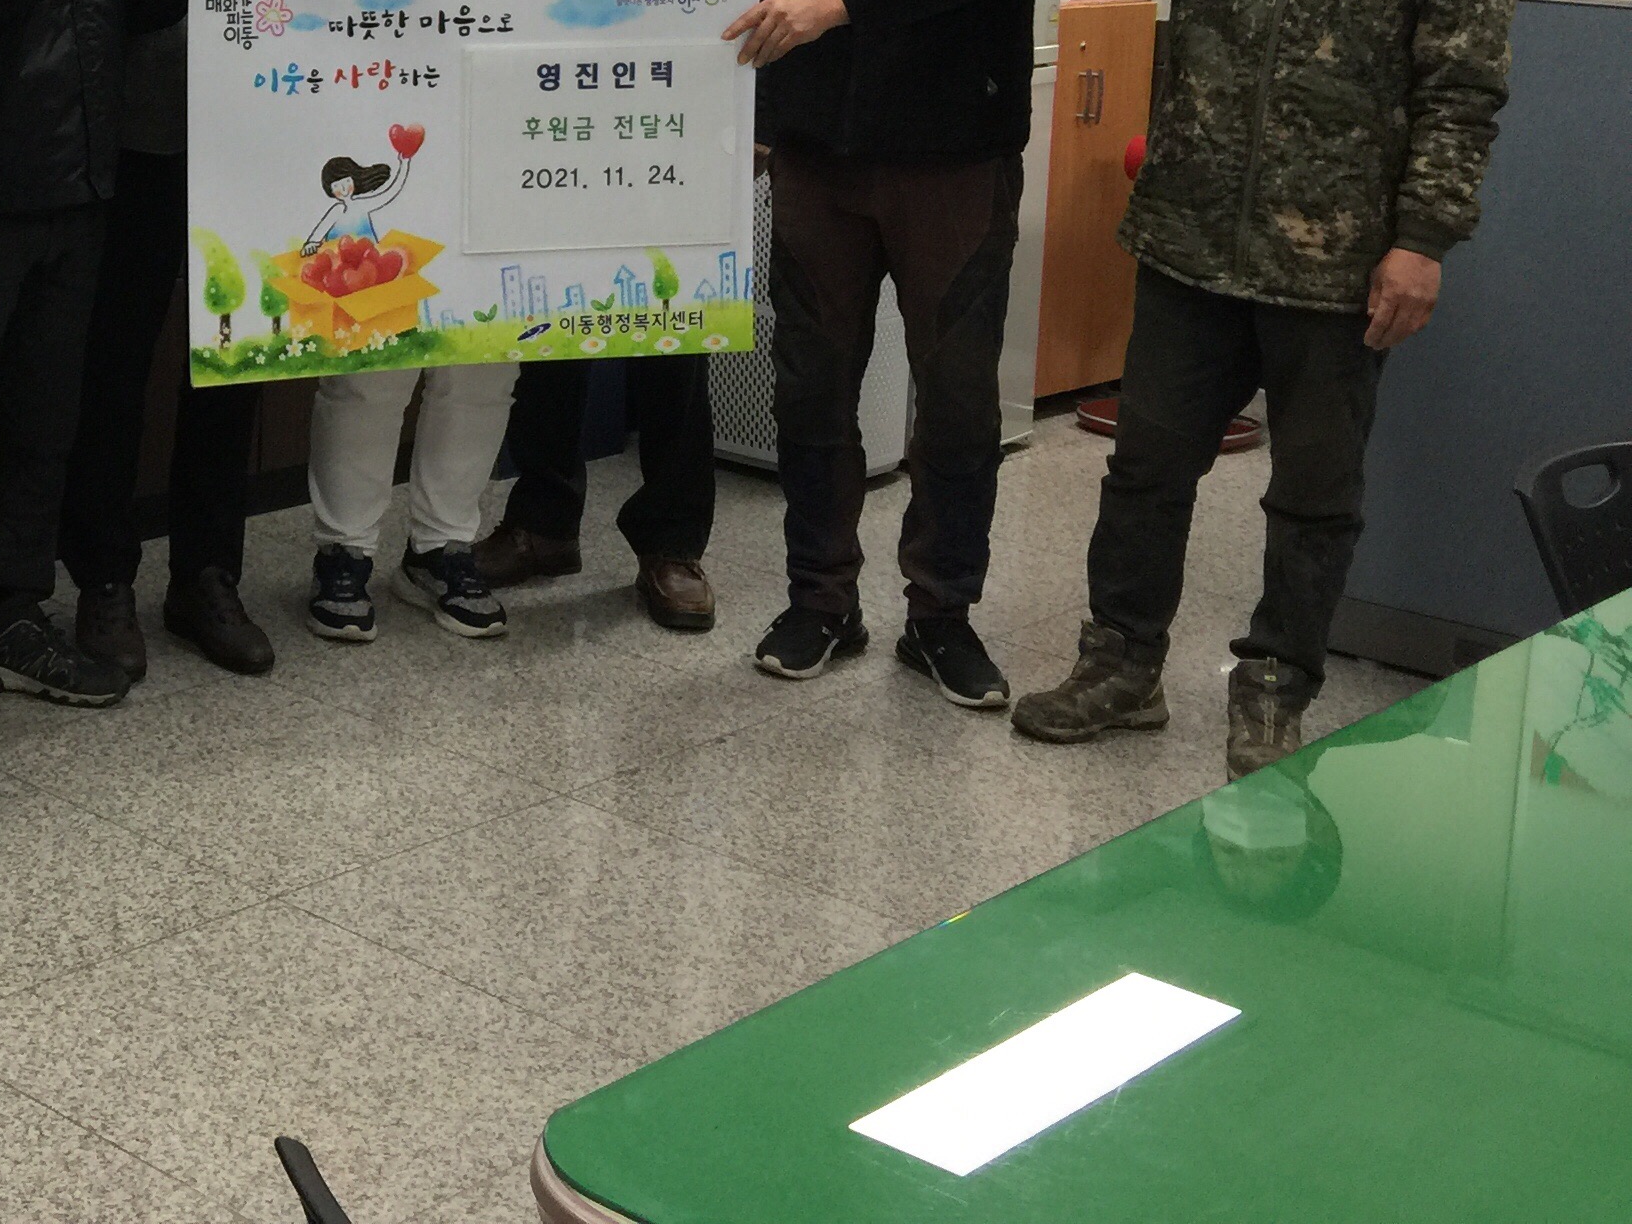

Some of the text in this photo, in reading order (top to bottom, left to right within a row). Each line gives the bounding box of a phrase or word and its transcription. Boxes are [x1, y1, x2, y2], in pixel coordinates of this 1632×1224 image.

[226, 9, 253, 25] 피는
[328, 5, 514, 39] 따뜻한 마음으로
[223, 26, 259, 50] 이동
[253, 59, 441, 95] 이웃을 사랑하는
[522, 113, 685, 142] 후원금 전달식
[521, 165, 685, 189] 2021. 11. 24.
[559, 310, 704, 336] 이동행정복지센터
